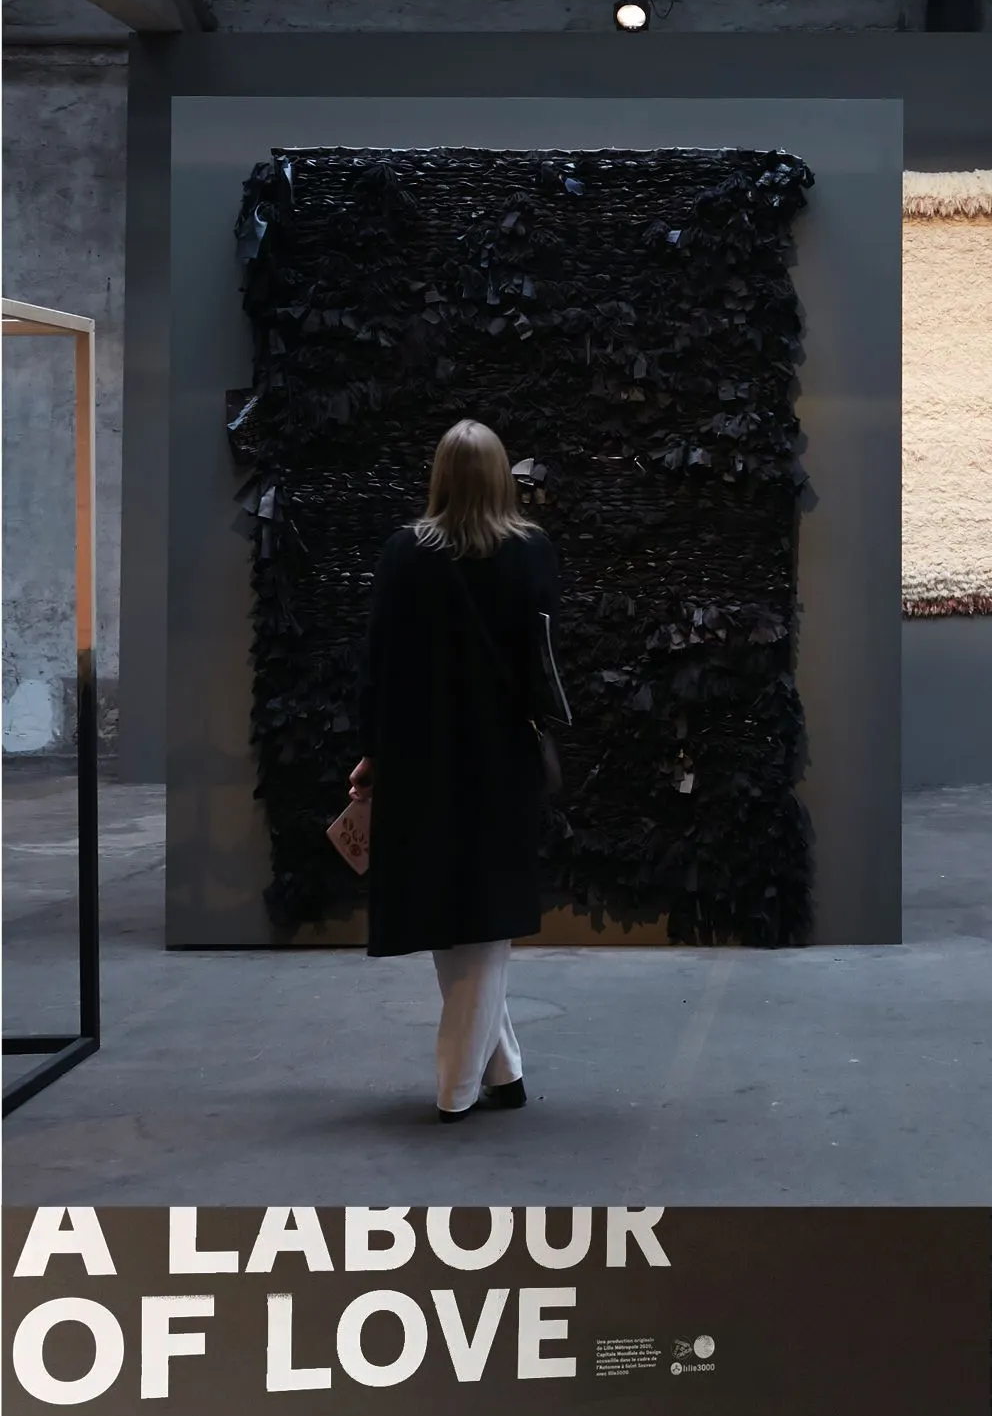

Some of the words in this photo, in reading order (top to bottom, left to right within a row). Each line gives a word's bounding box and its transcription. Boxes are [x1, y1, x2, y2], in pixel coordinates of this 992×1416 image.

[12, 1206, 118, 1278] A
[168, 1206, 672, 1275] LABOUR
[12, 1292, 215, 1405] OF
[266, 1286, 577, 1393] LOVE
